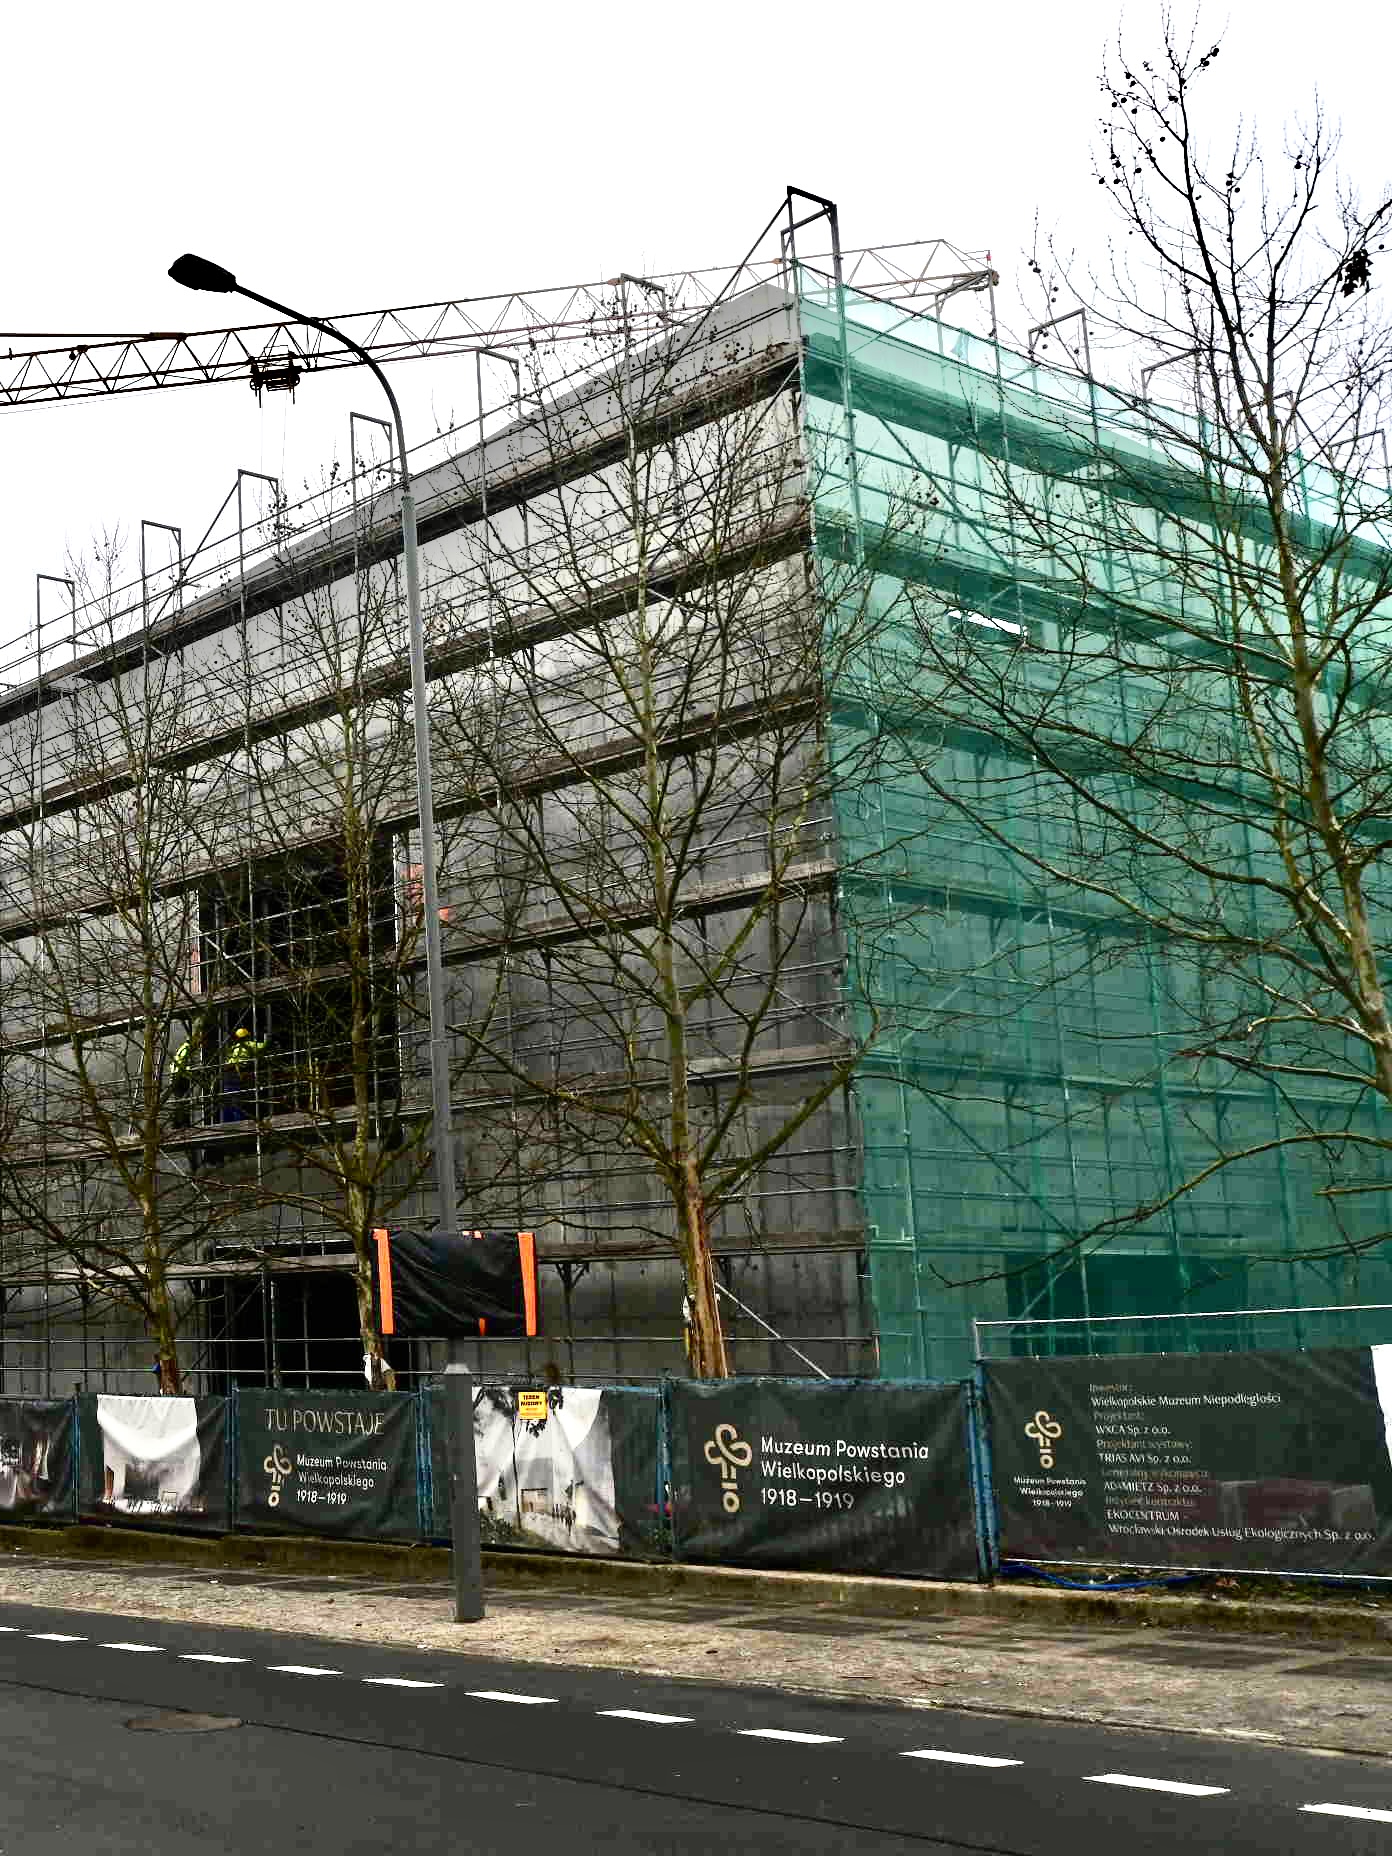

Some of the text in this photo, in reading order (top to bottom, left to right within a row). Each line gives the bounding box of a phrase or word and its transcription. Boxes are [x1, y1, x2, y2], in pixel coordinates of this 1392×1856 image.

[1091, 1395, 1157, 1408] Wielkopolskie
[1159, 1395, 1201, 1406] Muzeum
[264, 1408, 385, 1435] TU POWSTAJE
[761, 1436, 929, 1459] Muzeum Powstania
[296, 1454, 387, 1472] Muzeum Powstania
[298, 1471, 374, 1491] Wielkopolskiego
[761, 1461, 905, 1488] Wielkopolskiego
